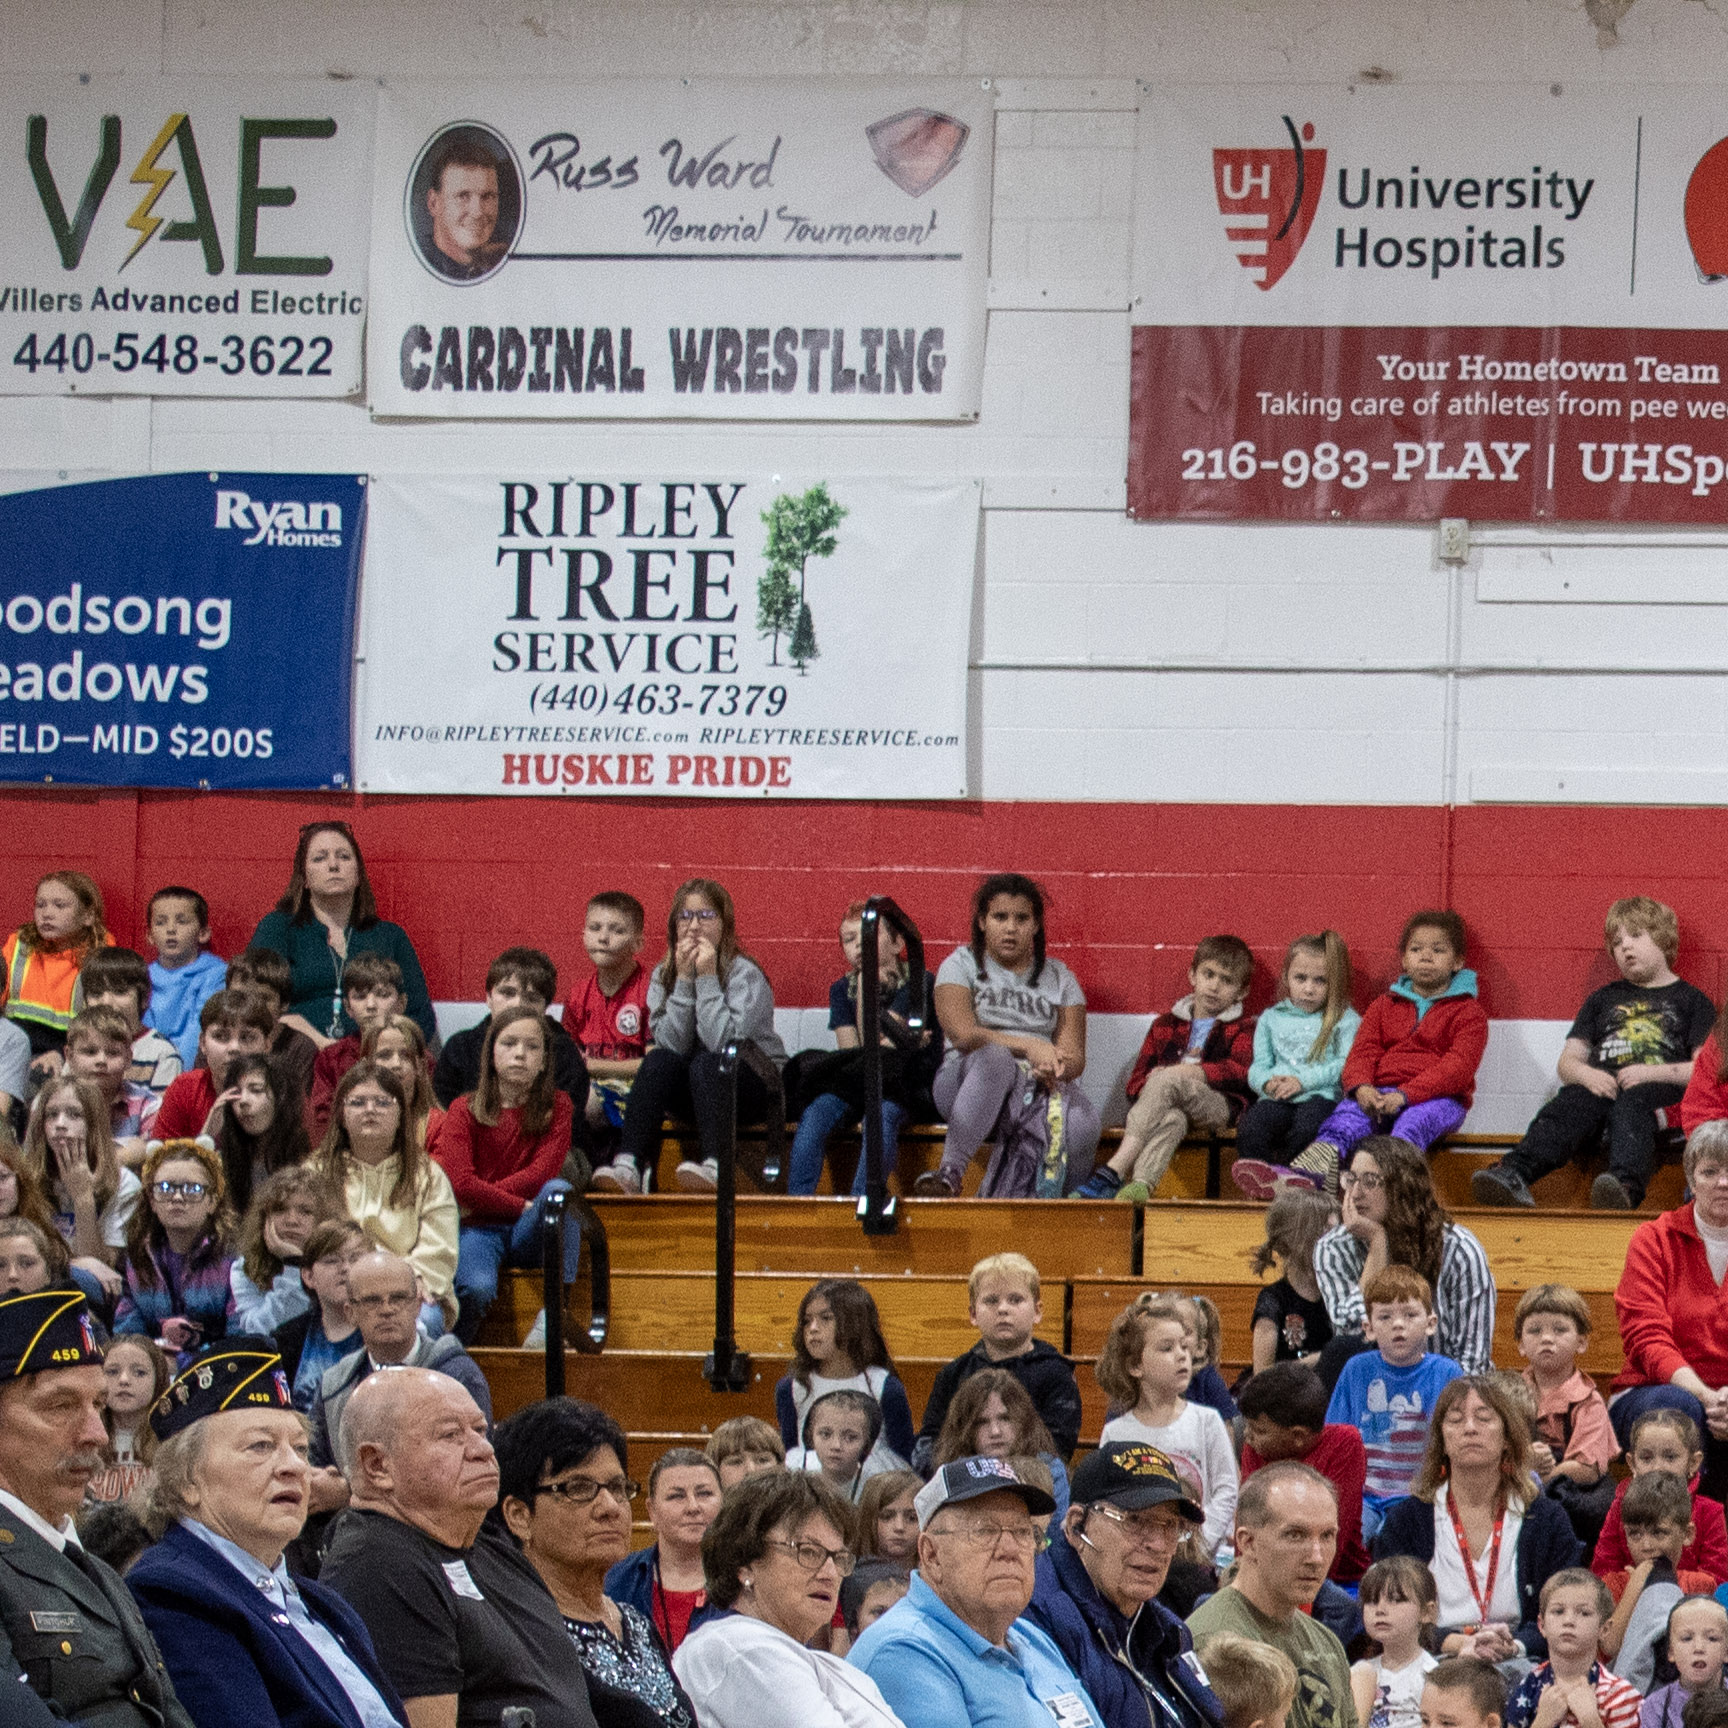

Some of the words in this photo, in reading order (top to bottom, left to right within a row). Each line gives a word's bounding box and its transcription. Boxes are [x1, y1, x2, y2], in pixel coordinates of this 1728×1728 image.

[528, 132, 640, 192] Russ
[659, 135, 782, 190] Ward
[1223, 164, 1271, 200] UH
[26, 112, 338, 276] VAE
[1336, 166, 1595, 221] University
[643, 205, 768, 246] Memorial
[776, 205, 938, 245] Tournament
[1334, 225, 1566, 280] Hospitals
[90, 286, 240, 315] Advanced
[252, 289, 362, 316] Electric
[13, 331, 333, 377] 440-548-3622
[399, 324, 646, 394] CARDINAL
[668, 326, 947, 395] WRESTLING
[1377, 354, 1451, 383] Your
[1458, 354, 1628, 385] Hometown
[1635, 357, 1721, 385] Team
[1256, 392, 1343, 421] Taking
[1350, 396, 1405, 418] care
[1412, 391, 1439, 418] of
[1447, 391, 1551, 419] athletes
[1556, 393, 1622, 419] from
[1629, 401, 1686, 425] pee
[1181, 442, 1531, 490] 216-983-PLAY
[213, 490, 343, 545] Ryan
[499, 481, 748, 539] RIPLEY
[267, 529, 342, 547] Homes
[495, 546, 740, 624] TREE
[0, 582, 233, 651] odsong
[492, 631, 740, 676] SERVICE
[168, 722, 275, 760] $200S
[699, 727, 960, 749] RIPLEYTREESERVICE.com
[501, 752, 655, 787] HUSKIE
[667, 753, 793, 790] PRIDE
[51, 1348, 81, 1362] 459
[247, 1391, 271, 1403] 459
